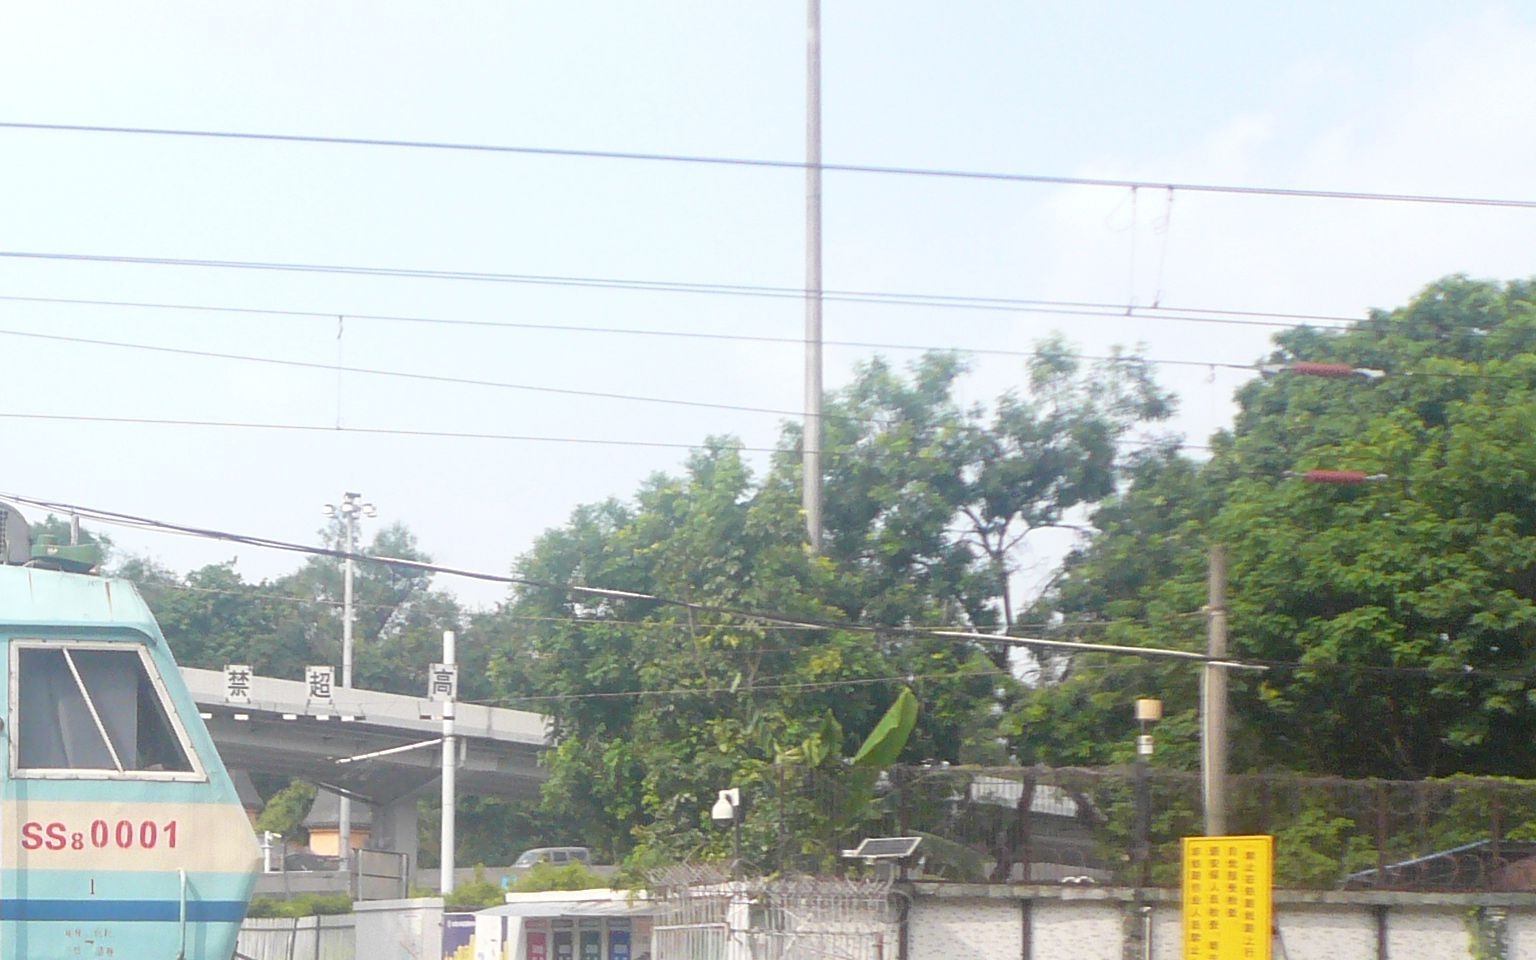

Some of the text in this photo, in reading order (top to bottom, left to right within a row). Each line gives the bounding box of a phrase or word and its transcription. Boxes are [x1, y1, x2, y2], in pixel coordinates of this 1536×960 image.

[227, 668, 454, 699] 禁 超 高
